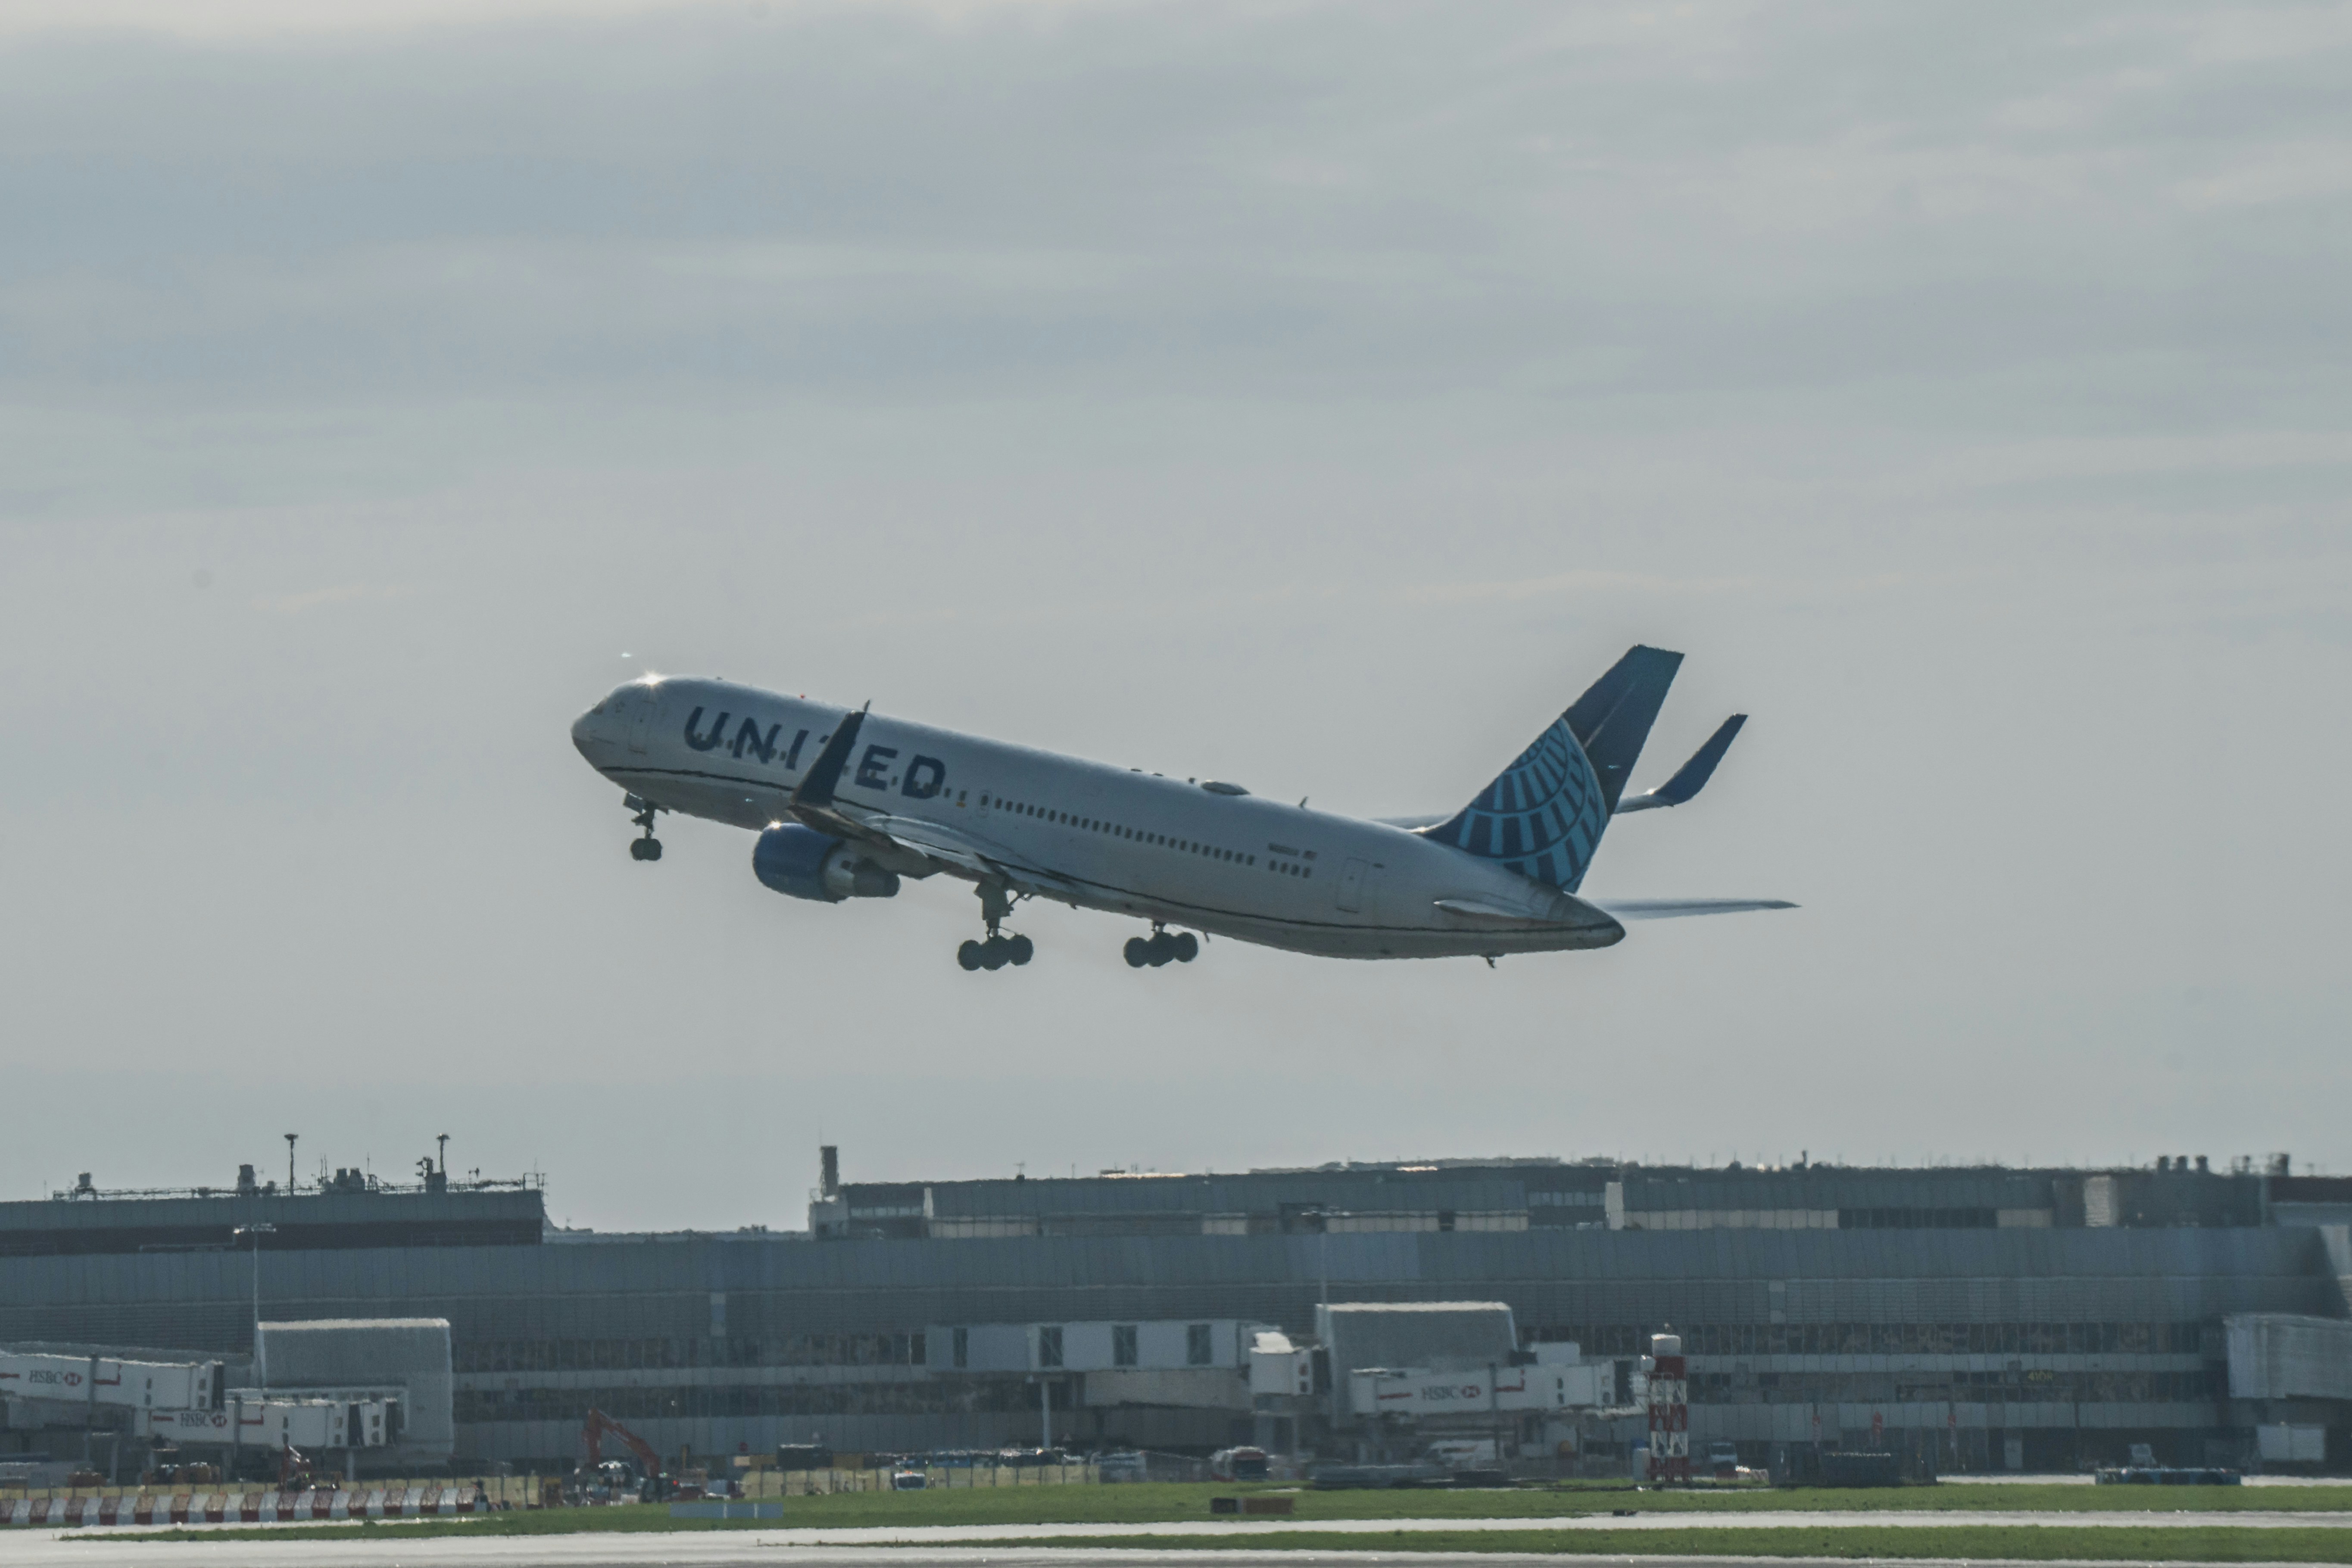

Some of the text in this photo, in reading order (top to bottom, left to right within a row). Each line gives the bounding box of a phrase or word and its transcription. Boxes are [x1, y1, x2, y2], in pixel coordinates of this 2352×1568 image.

[684, 707, 945, 799] UNIED
[29, 1370, 62, 1384] HSBC
[1422, 1385, 1460, 1400] HSBC
[181, 1413, 209, 1427] HSBC
